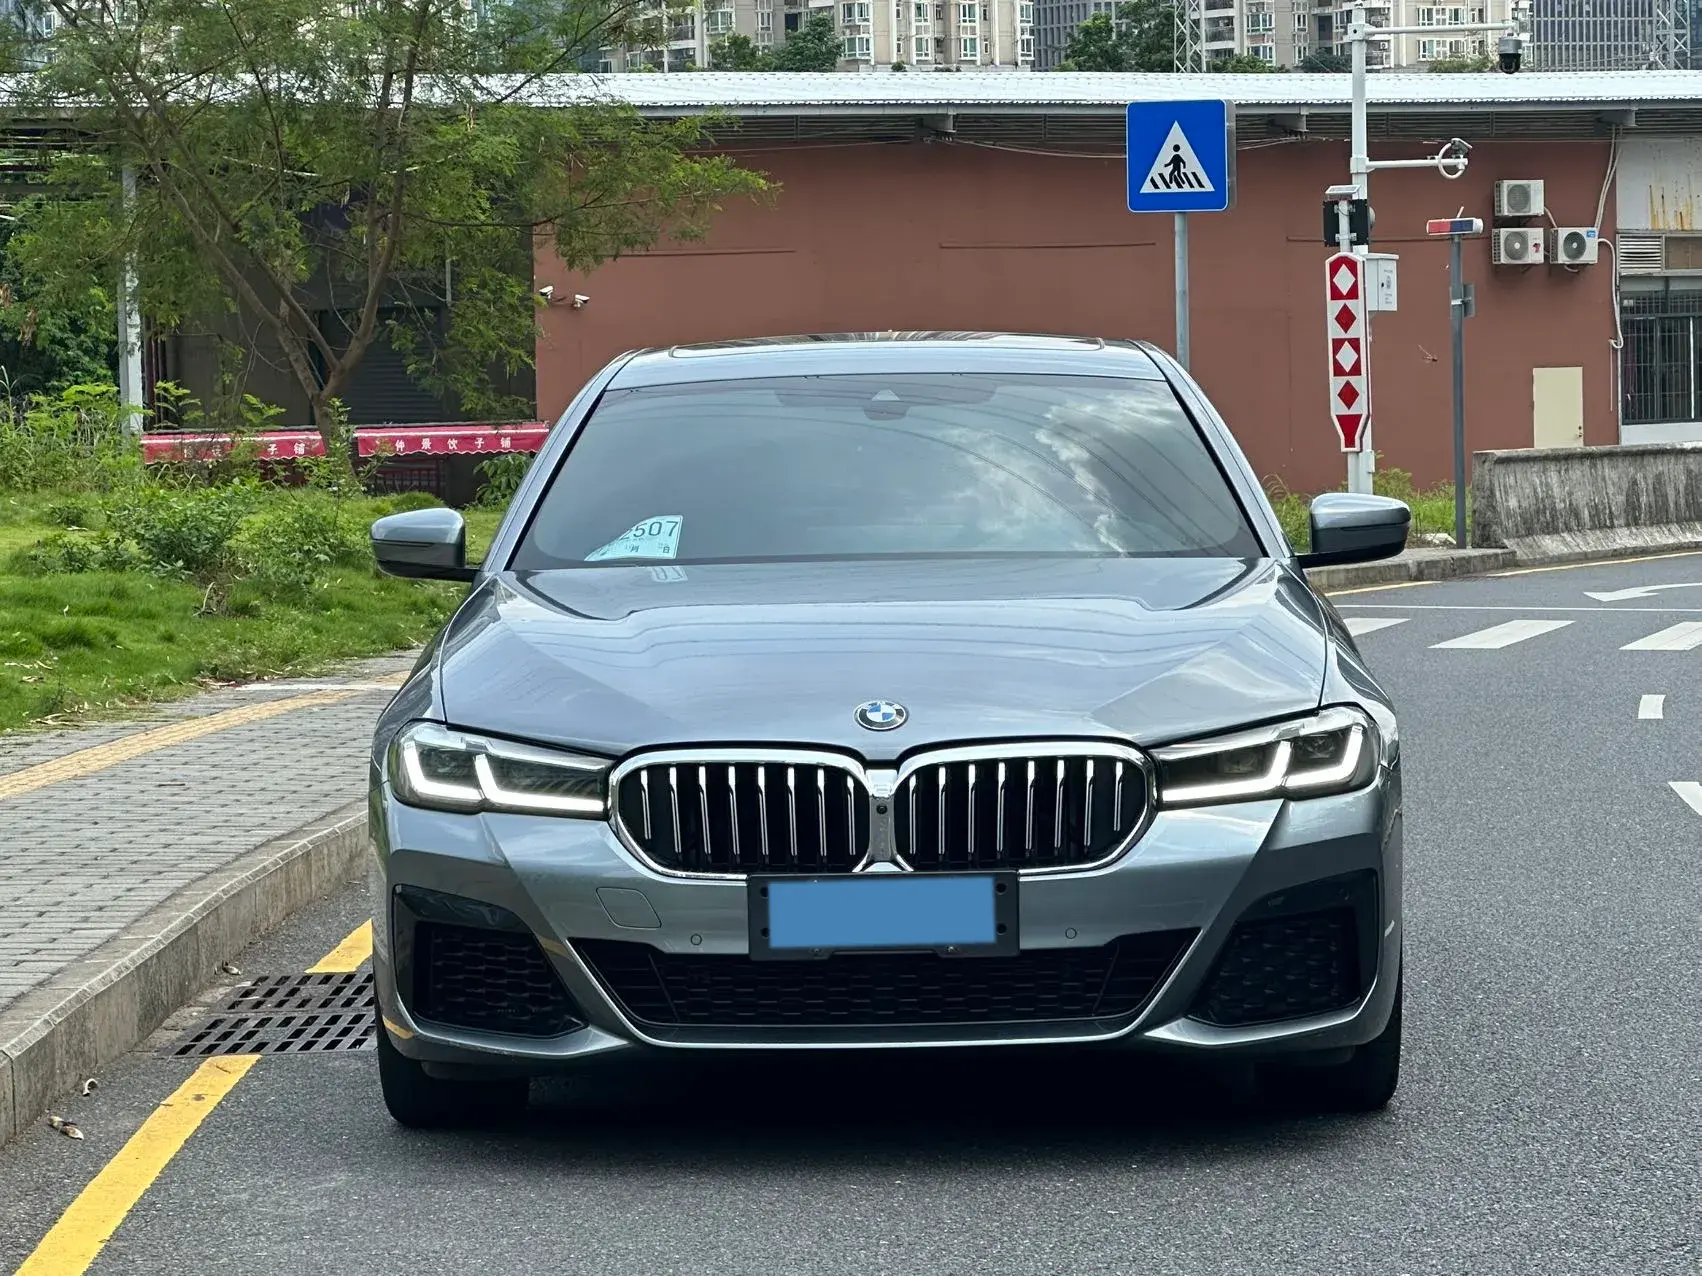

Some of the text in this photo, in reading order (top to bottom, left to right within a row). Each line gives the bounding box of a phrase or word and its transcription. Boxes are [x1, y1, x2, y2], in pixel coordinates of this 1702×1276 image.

[395, 437, 511, 452] 仲景饮子铺
